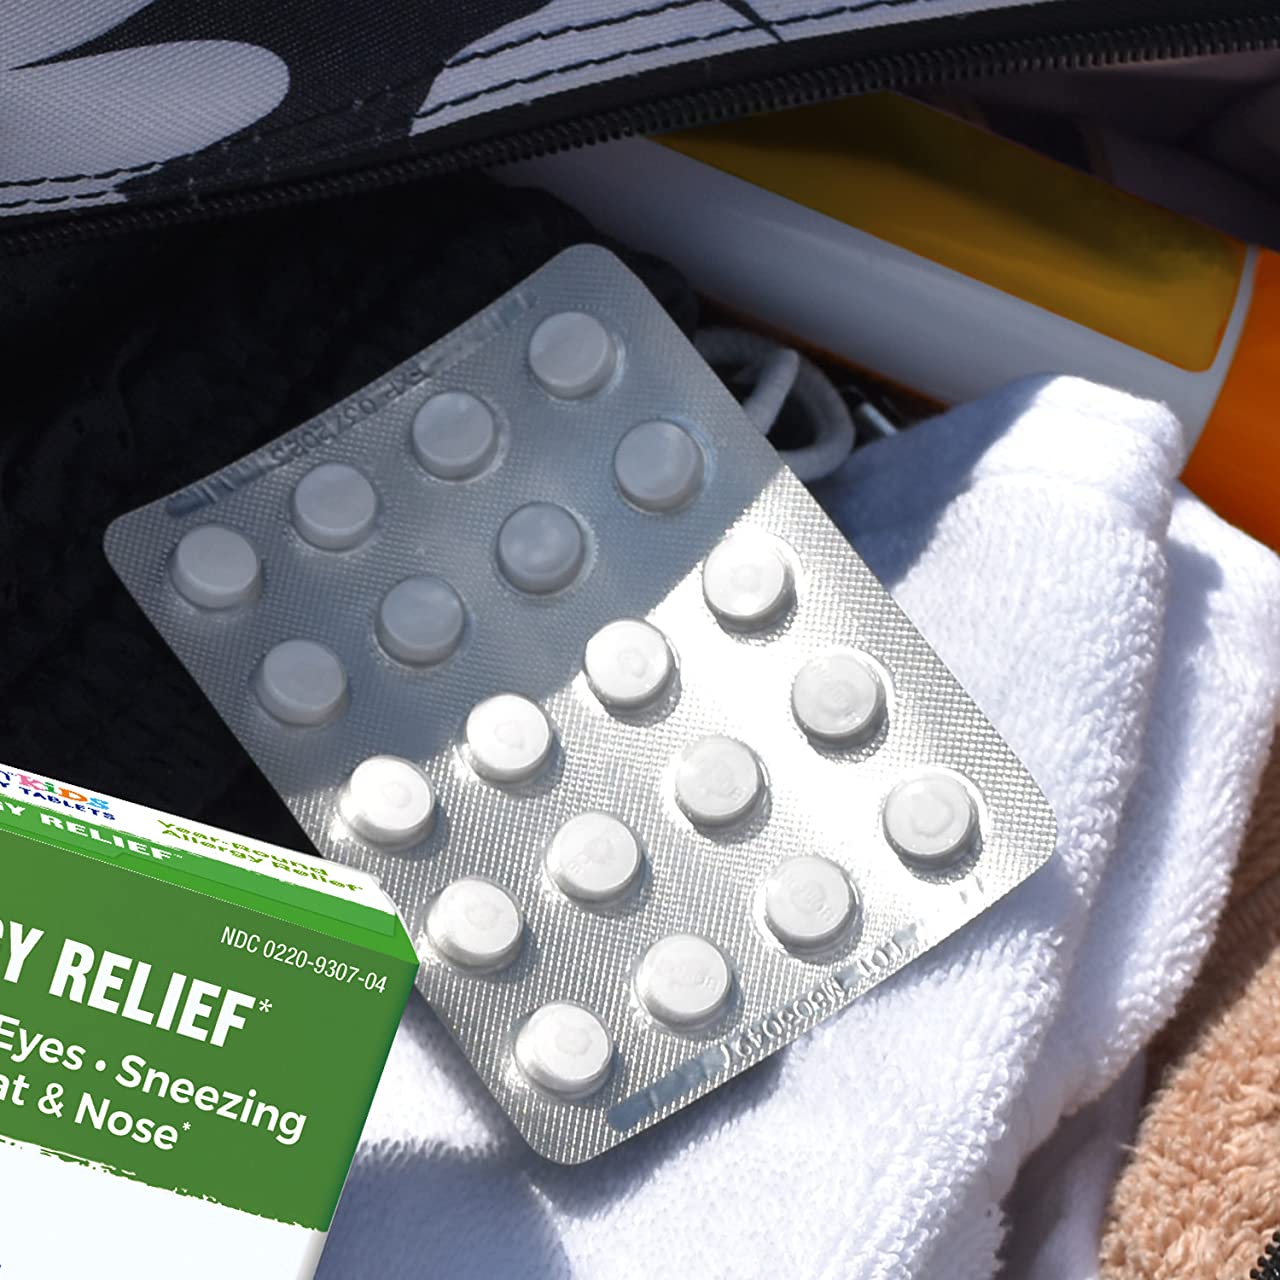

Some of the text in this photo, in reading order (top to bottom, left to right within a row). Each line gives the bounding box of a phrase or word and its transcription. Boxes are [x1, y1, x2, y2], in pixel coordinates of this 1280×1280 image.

[18, 787, 116, 821] TABLETS
[157, 819, 330, 877] Year-Round
[162, 829, 264, 865] Allergy
[220, 925, 388, 994] NDC 0220-9307-04
[36, 1082, 64, 1117] &
[116, 1054, 307, 1145] Sneezing
